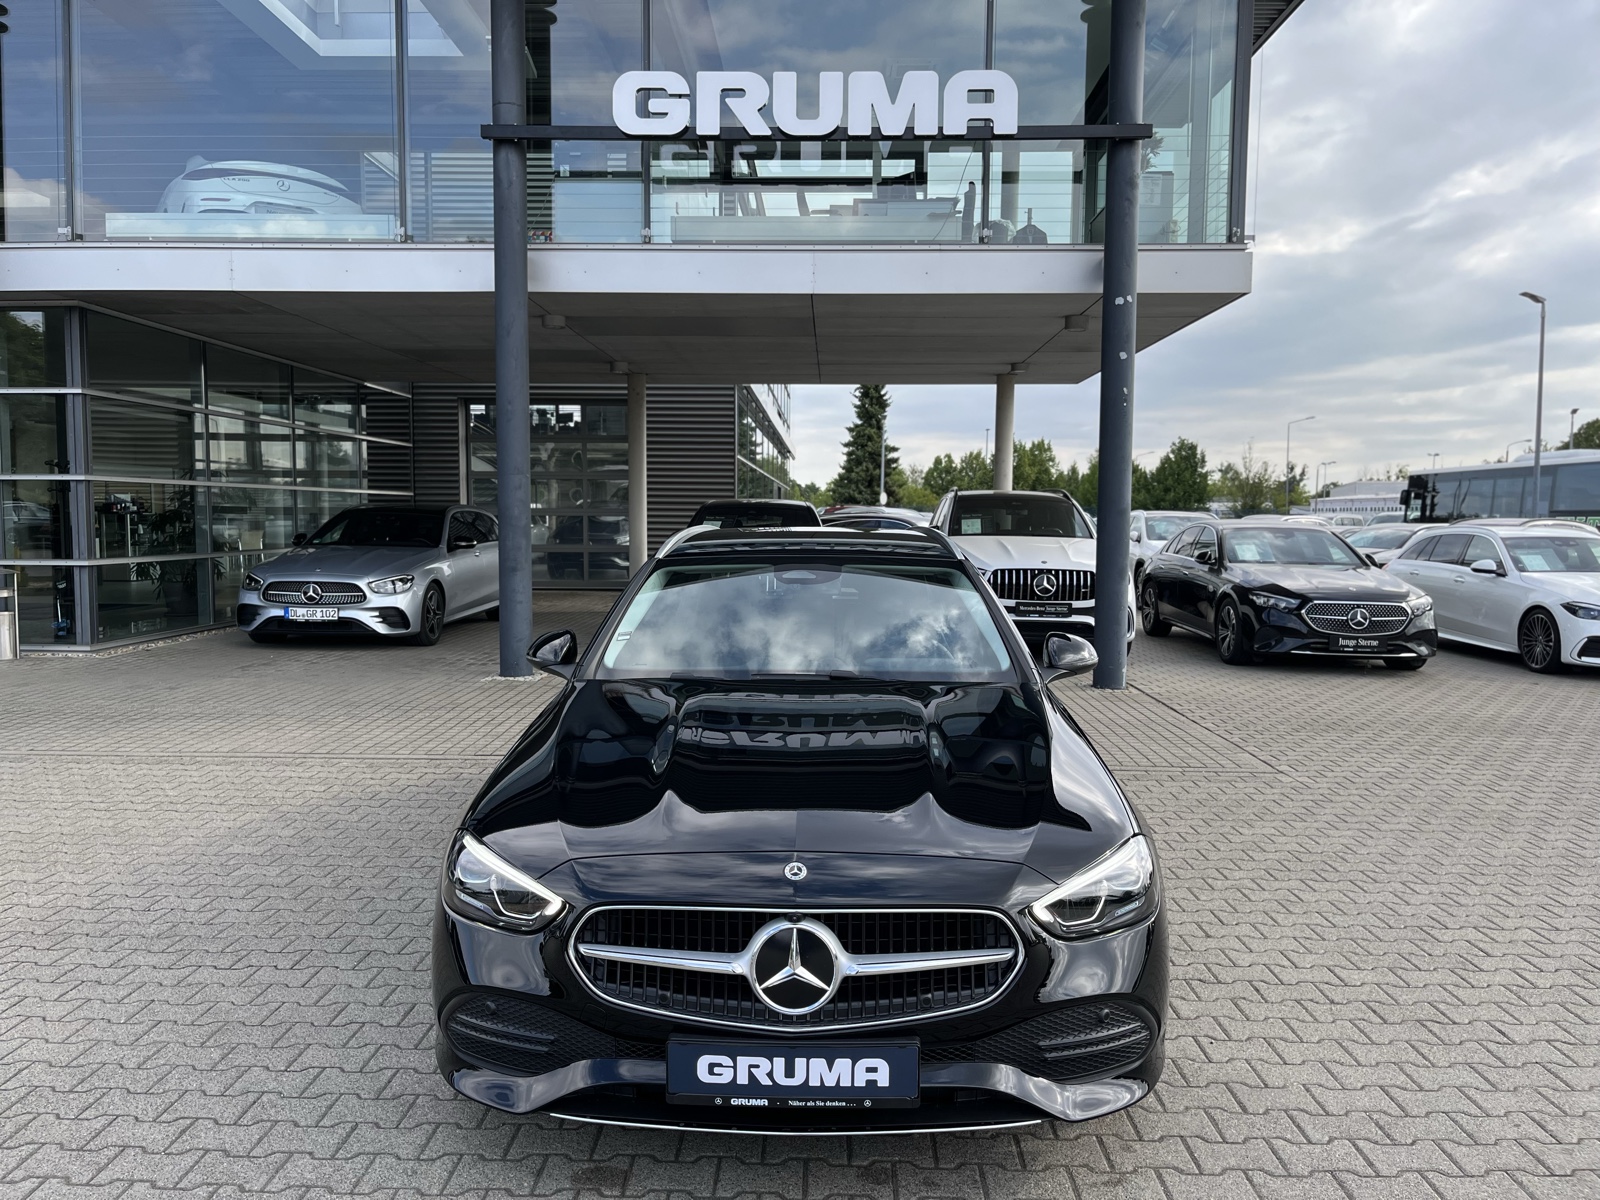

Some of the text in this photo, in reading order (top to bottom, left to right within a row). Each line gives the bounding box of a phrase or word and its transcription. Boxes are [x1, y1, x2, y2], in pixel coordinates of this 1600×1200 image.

[612, 70, 1019, 136] GRUMA
[290, 608, 337, 618] DL GR 102
[1338, 637, 1379, 647] Junge Sterne
[696, 1054, 890, 1087] GRUMA
[731, 1098, 769, 1106] GRUMA
